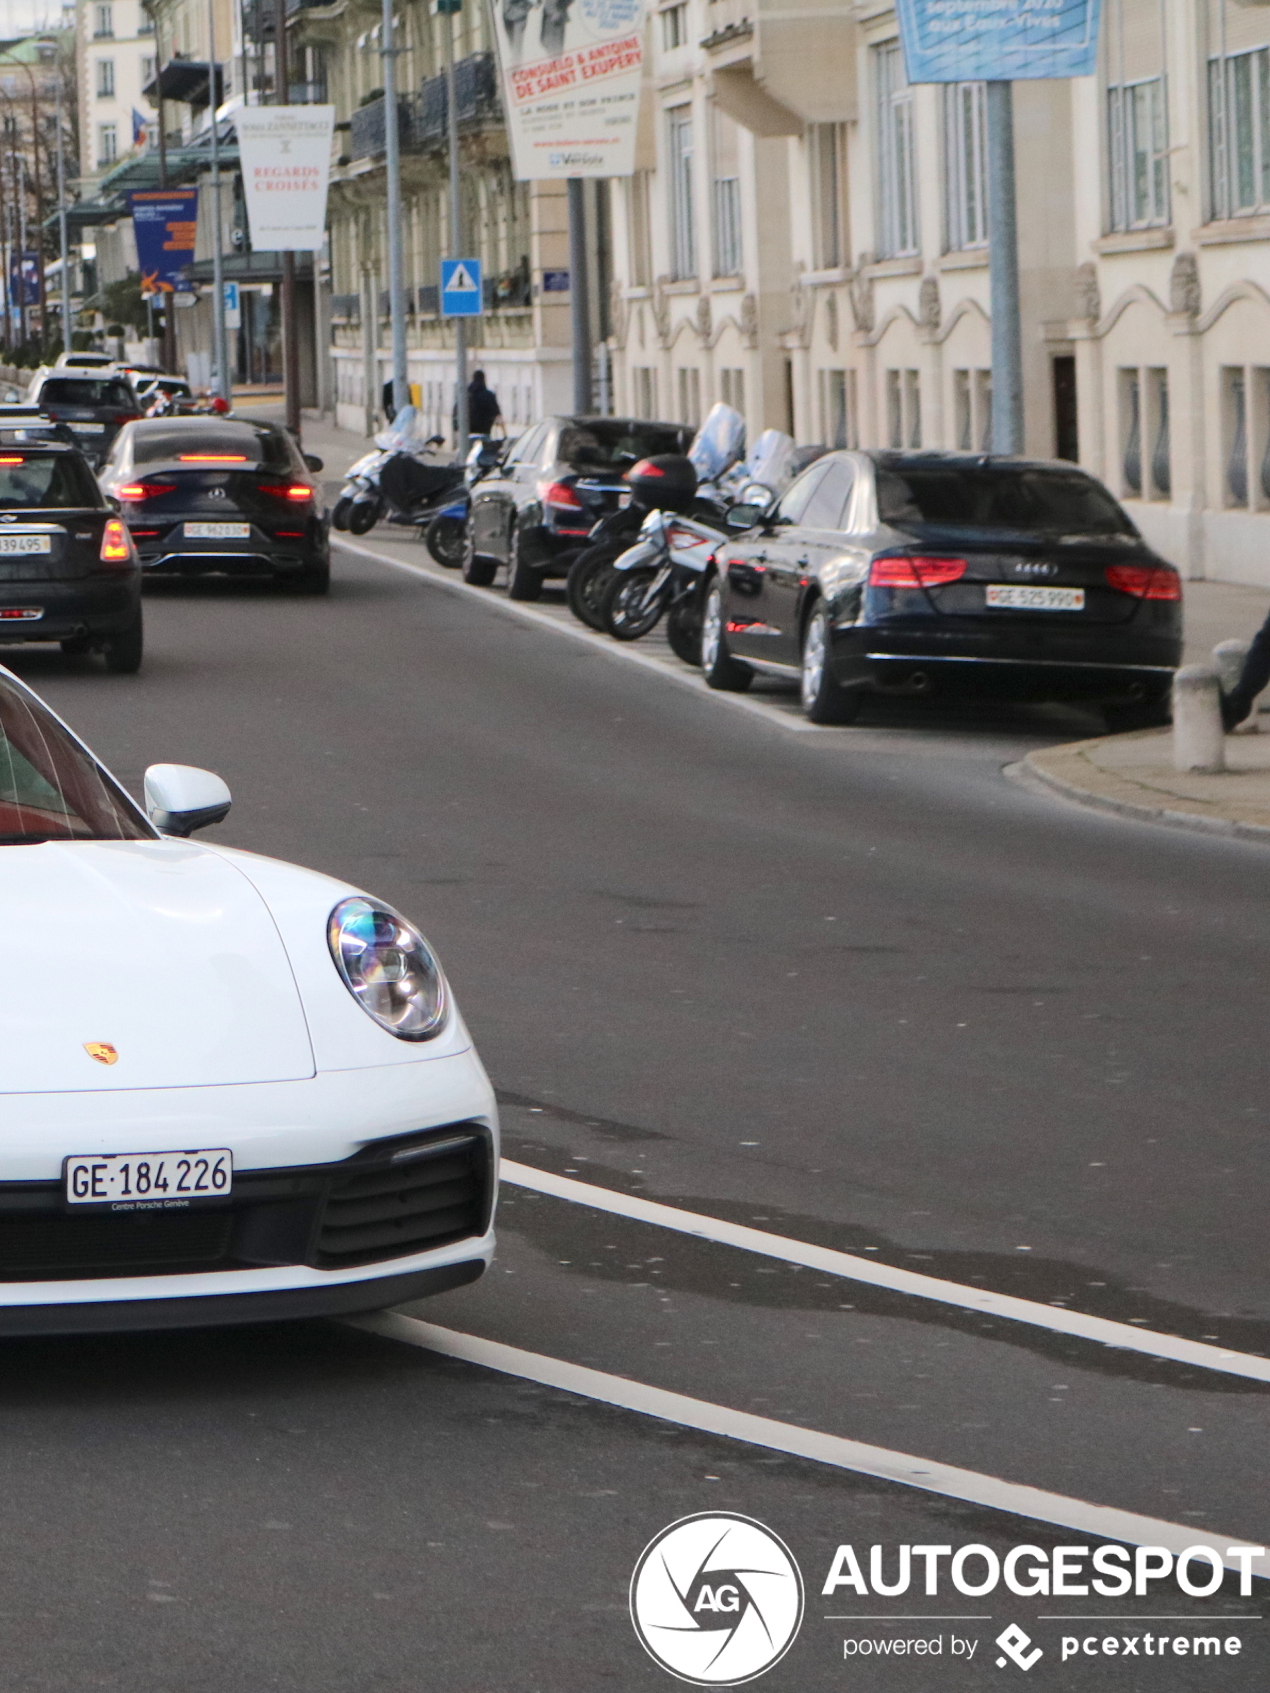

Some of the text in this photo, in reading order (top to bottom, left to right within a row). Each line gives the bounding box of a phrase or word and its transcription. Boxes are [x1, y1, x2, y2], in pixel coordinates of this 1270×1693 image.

[512, 56, 574, 83] CONSUELO
[589, 37, 638, 61] ANTOINE
[516, 51, 642, 99] DE SAINT EXUPERY
[254, 167, 320, 178] REGARDS
[112, 1199, 190, 1212] Centre Porsche Genève
